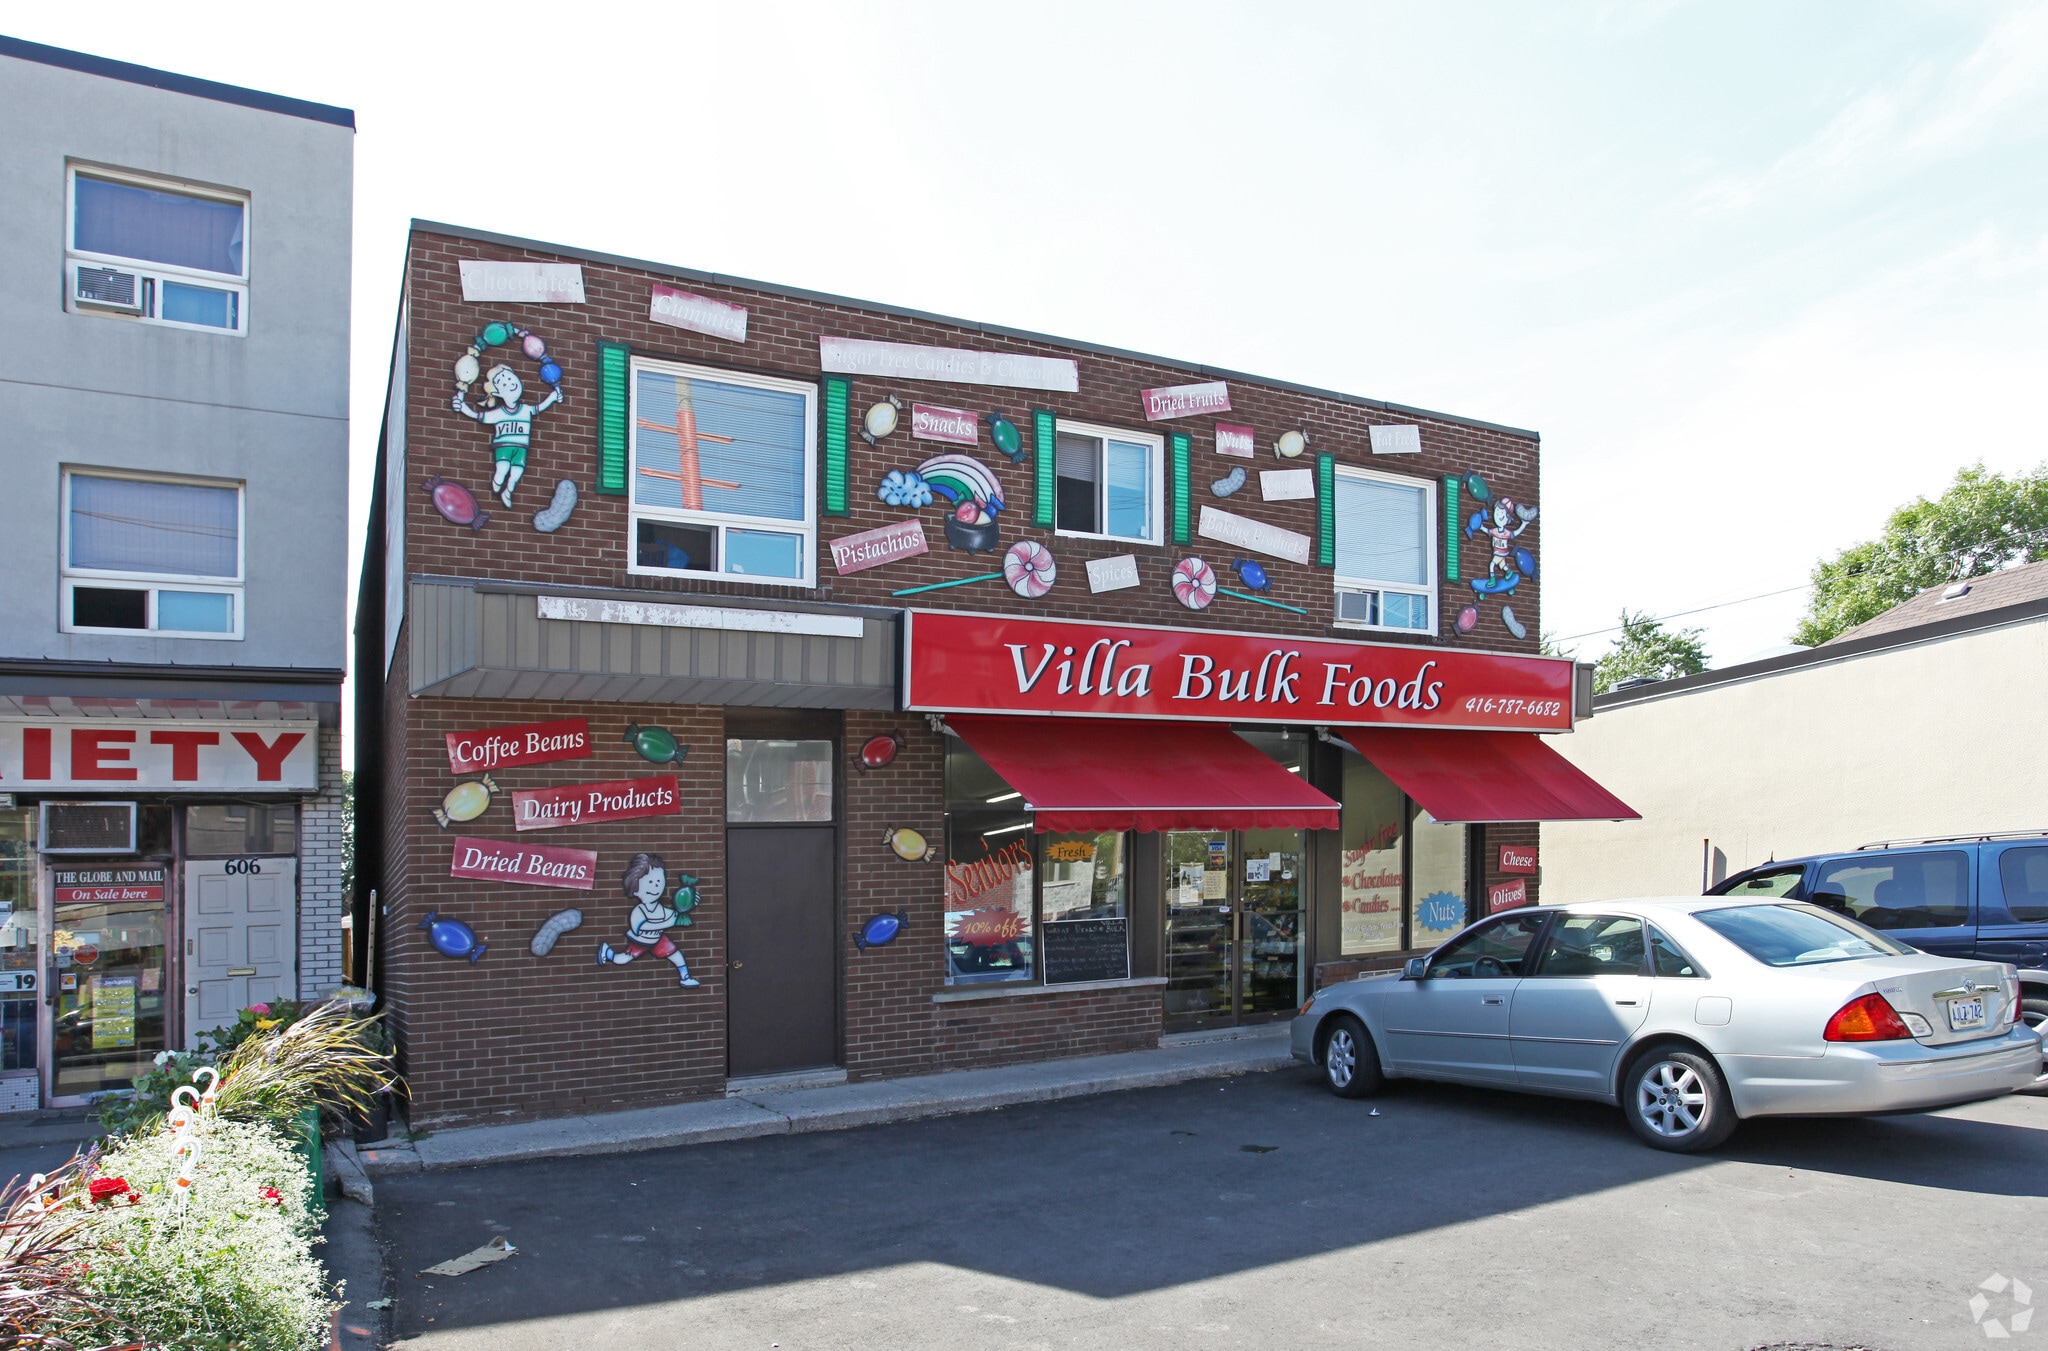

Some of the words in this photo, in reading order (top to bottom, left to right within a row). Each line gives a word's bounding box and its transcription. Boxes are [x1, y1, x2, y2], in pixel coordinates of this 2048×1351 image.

[827, 344, 875, 371] Sugar
[879, 349, 909, 369] Free
[915, 353, 975, 375] Candies
[980, 358, 993, 374] &
[1150, 395, 1185, 414] Dried
[1189, 394, 1225, 409] Fruits
[498, 424, 524, 435] Villa
[919, 412, 973, 436] Snacks
[1221, 430, 1252, 451] Nuts
[1377, 432, 1393, 447] Fat
[1395, 432, 1416, 447] Free
[1206, 516, 1247, 545] Baking
[1250, 526, 1304, 557] Products
[838, 531, 921, 566] Pistachios
[1092, 566, 1134, 586] Spices
[1004, 637, 1156, 698] Villa
[1172, 650, 1300, 705] Bulk
[1315, 660, 1446, 711] Foods
[1465, 697, 1560, 717] 416-787-6682
[0, 728, 306, 781] IETY
[456, 736, 520, 766] Coffee
[525, 731, 585, 755] Beans
[523, 796, 582, 822] Dairy
[588, 787, 673, 813] Products
[1057, 846, 1086, 858] Fresh
[1344, 837, 1375, 868] Sugar
[1377, 822, 1398, 853] free
[224, 858, 260, 875] 606
[462, 848, 523, 874] Dried
[526, 855, 586, 880] Beans
[1503, 851, 1533, 866] Cheese
[56, 872, 77, 883] THE
[79, 871, 113, 882] GLOBE
[115, 871, 136, 881] AND
[138, 870, 164, 881] MAIL
[947, 837, 1033, 903] Seniors
[1352, 868, 1404, 890] Chocolates
[72, 889, 90, 900] On
[93, 888, 119, 899] Sale
[121, 888, 148, 898] here
[1493, 886, 1523, 906] Olives
[1428, 901, 1455, 921] Nuts
[964, 921, 991, 934] 10%
[994, 917, 1018, 938] off
[15, 974, 36, 989] 19
